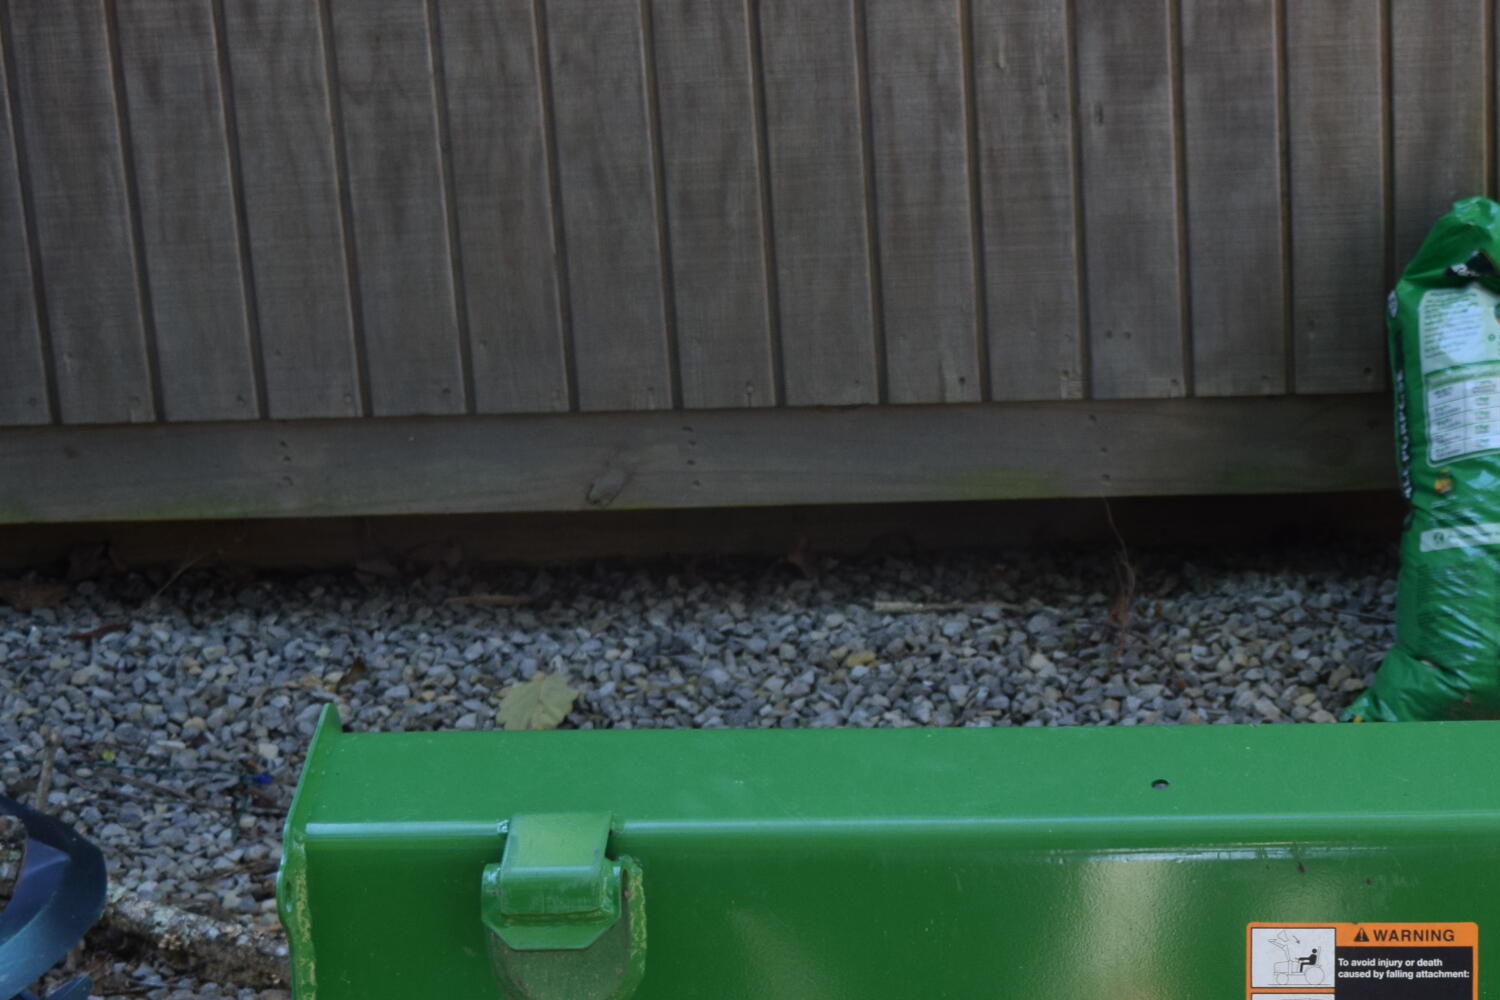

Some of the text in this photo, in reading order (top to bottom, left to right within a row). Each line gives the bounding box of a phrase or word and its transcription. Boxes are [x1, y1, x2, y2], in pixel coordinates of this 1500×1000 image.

[1373, 929, 1455, 942] WARNING
[1338, 957, 1443, 969] To avoid injury or death
[1338, 969, 1470, 981] caused by falling attachment:
